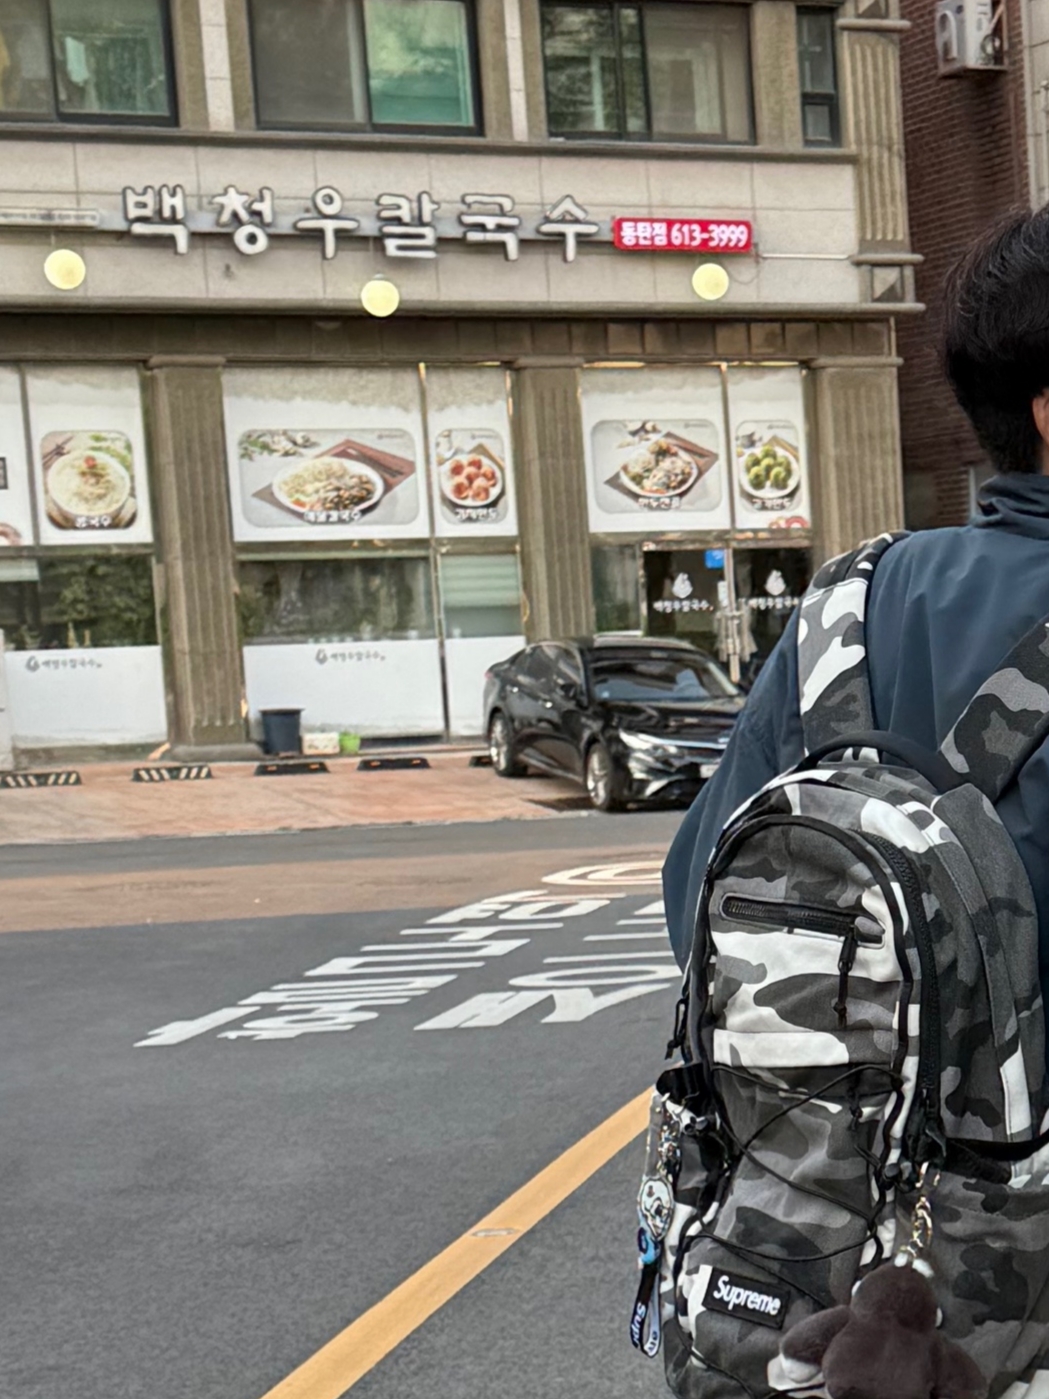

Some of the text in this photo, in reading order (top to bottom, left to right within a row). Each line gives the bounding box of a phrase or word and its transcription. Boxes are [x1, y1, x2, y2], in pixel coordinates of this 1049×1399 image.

[122, 185, 599, 263] 백청우칼국수
[620, 221, 748, 247] 동탄점 613-3999
[713, 1275, 781, 1315] Supreme
